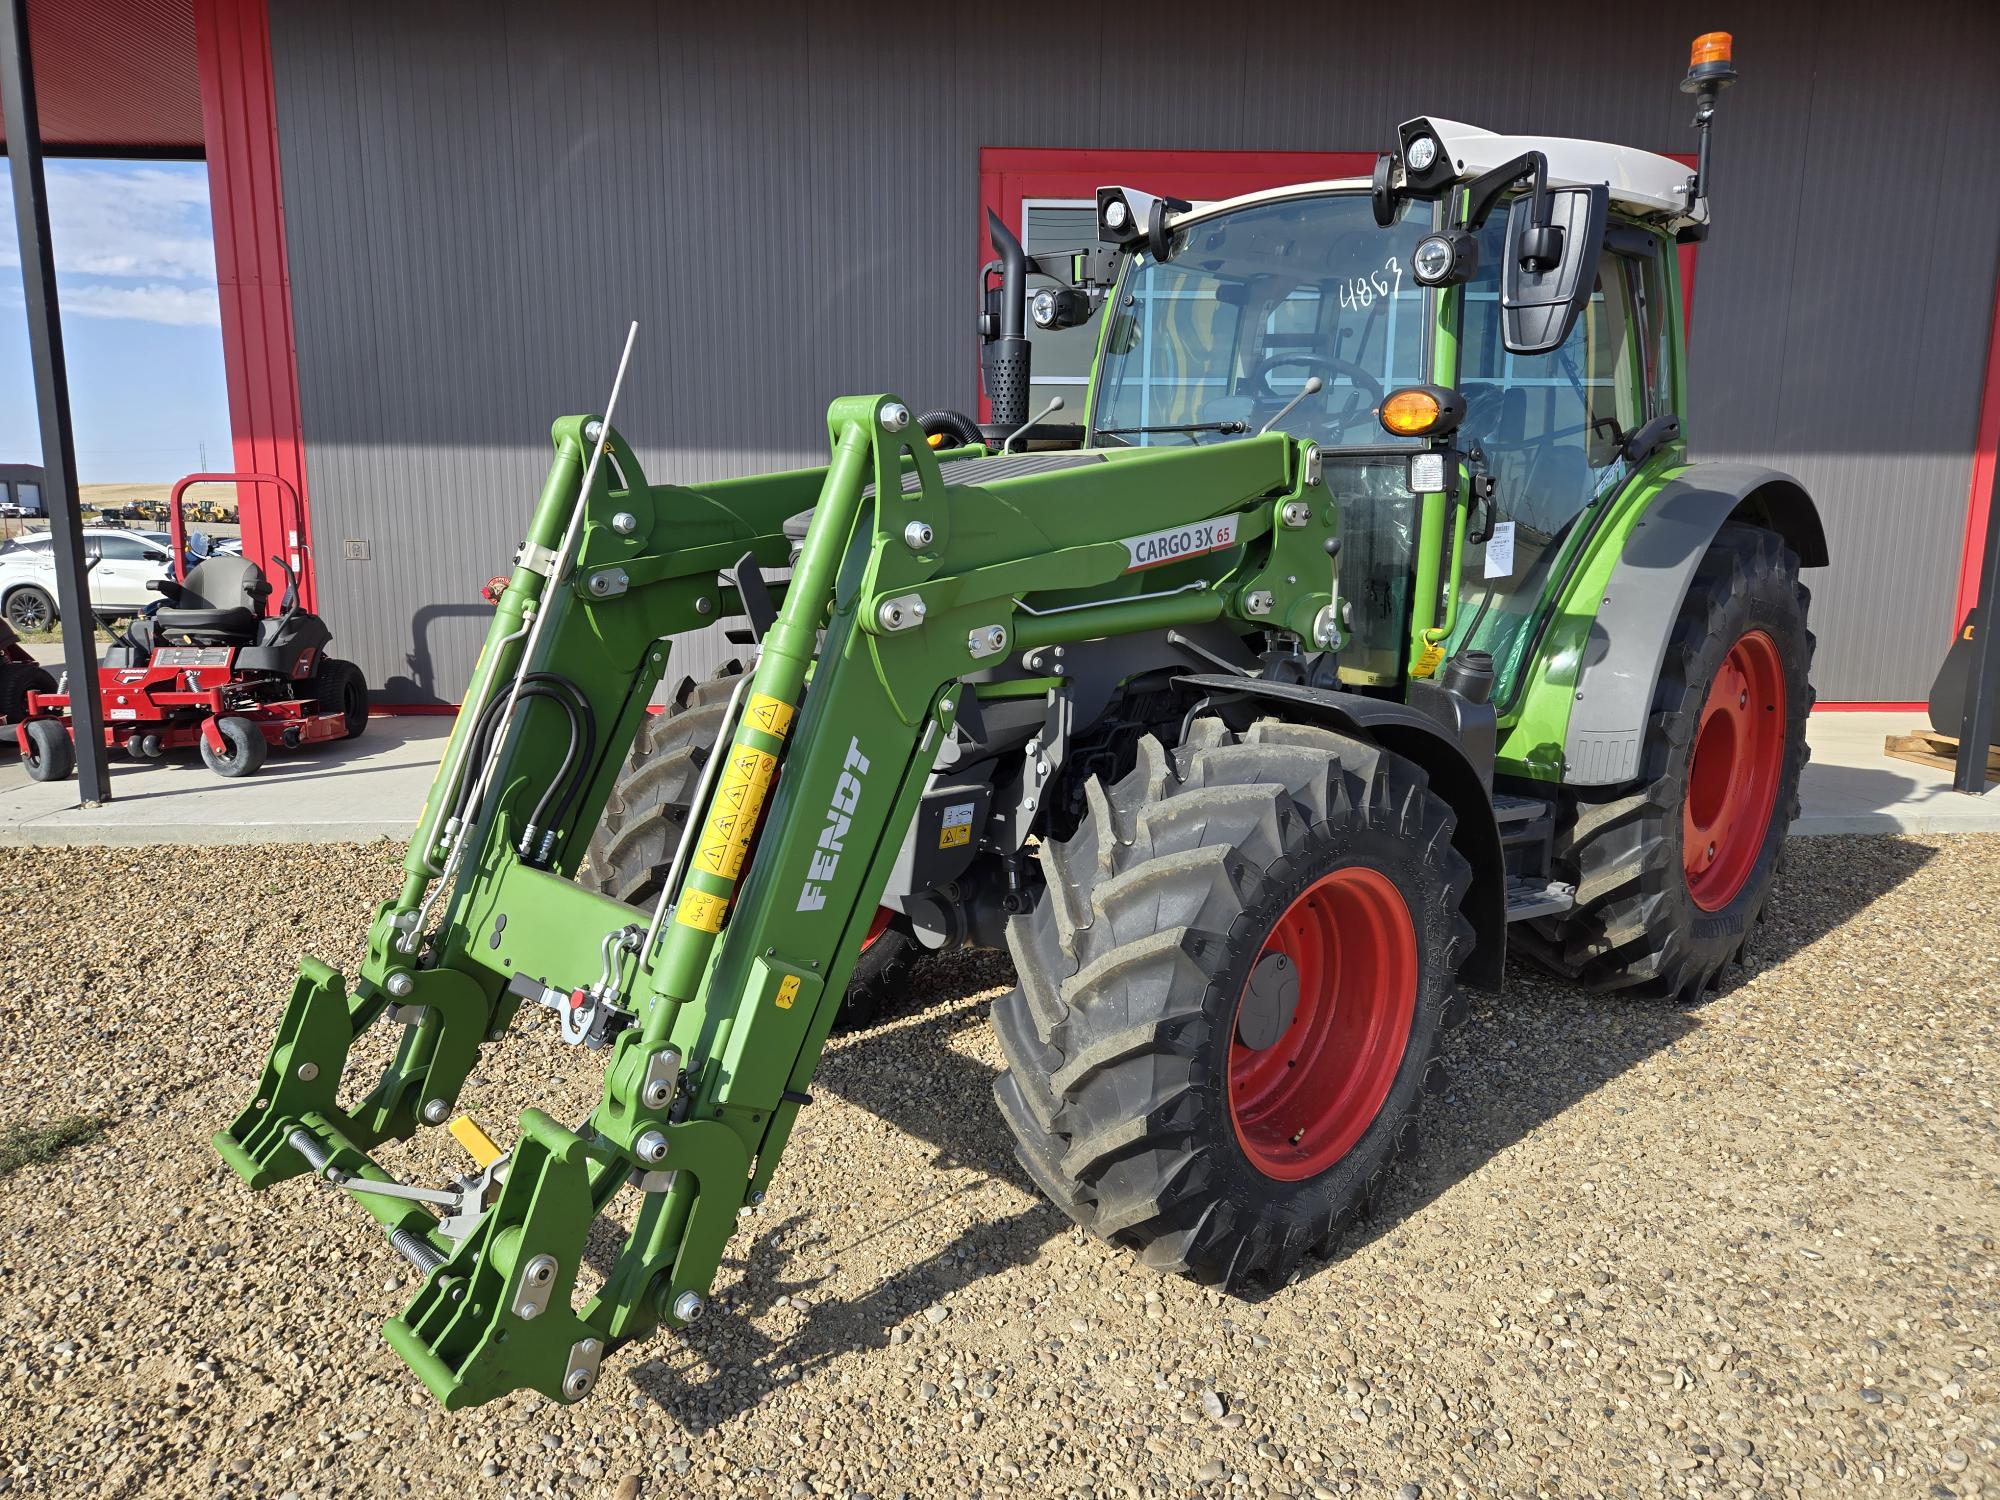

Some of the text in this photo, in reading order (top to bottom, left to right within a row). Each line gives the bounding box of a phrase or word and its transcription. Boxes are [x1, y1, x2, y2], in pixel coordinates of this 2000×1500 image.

[1340, 256, 1402, 311] 4863
[1136, 526, 1230, 563] CARGO 3X 65
[796, 735, 870, 912] FENDT
